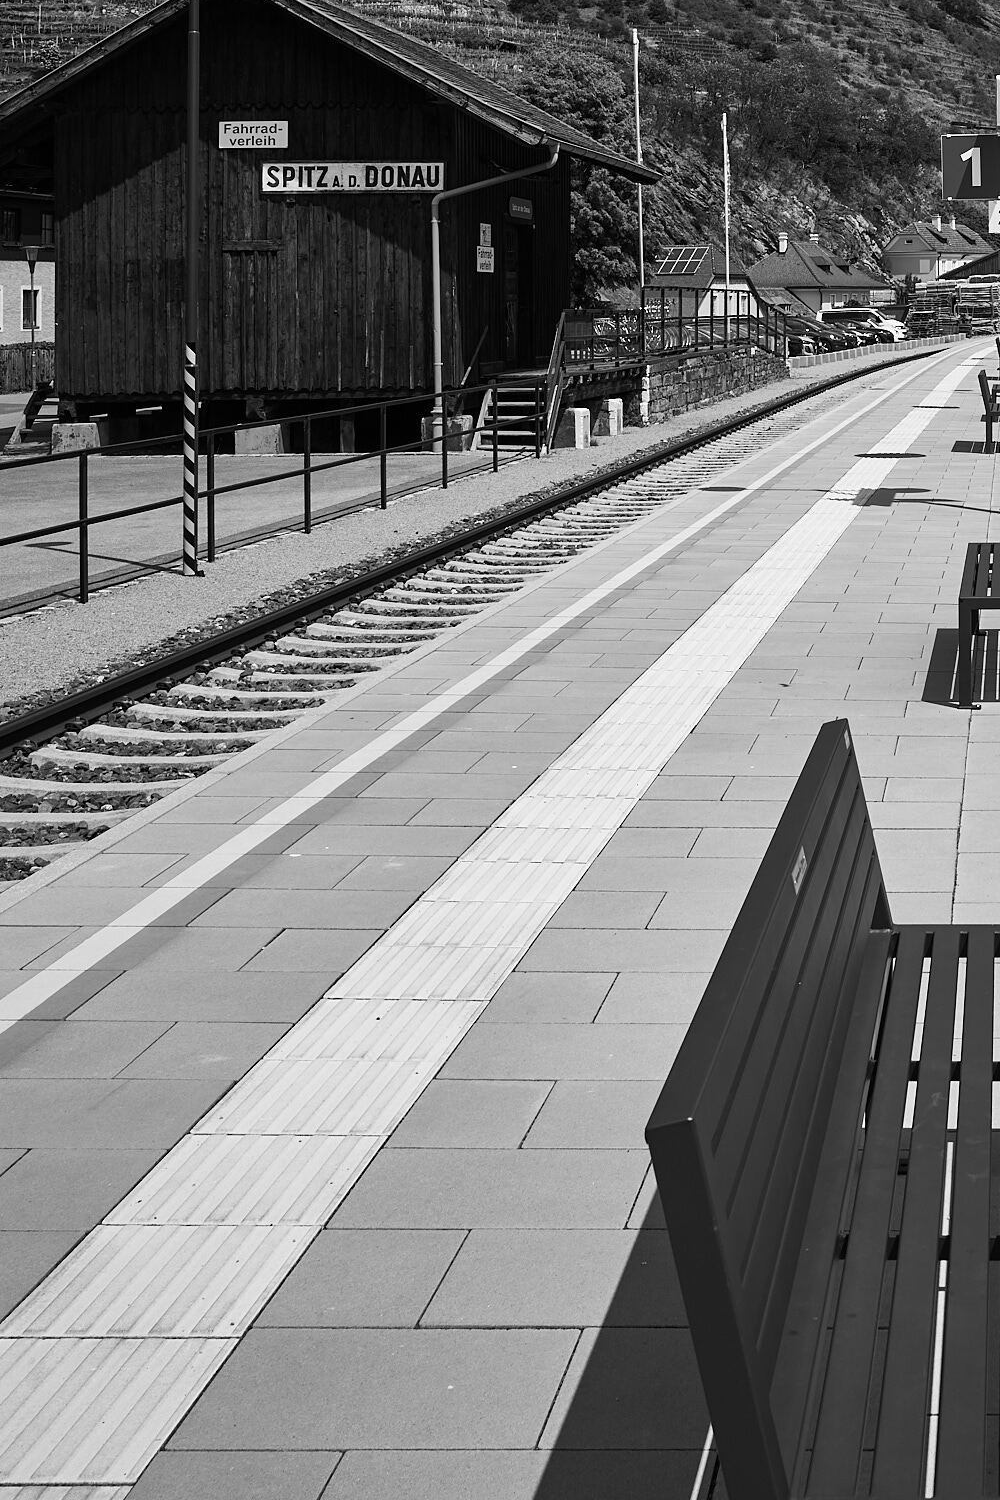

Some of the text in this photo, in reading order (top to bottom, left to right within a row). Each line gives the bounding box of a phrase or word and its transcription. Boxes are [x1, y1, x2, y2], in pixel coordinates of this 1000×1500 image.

[223, 123, 283, 134] Fahrrad-
[229, 135, 276, 146] verleih
[960, 147, 982, 187] 1
[266, 165, 440, 188] SPITZ A. D. DONAU
